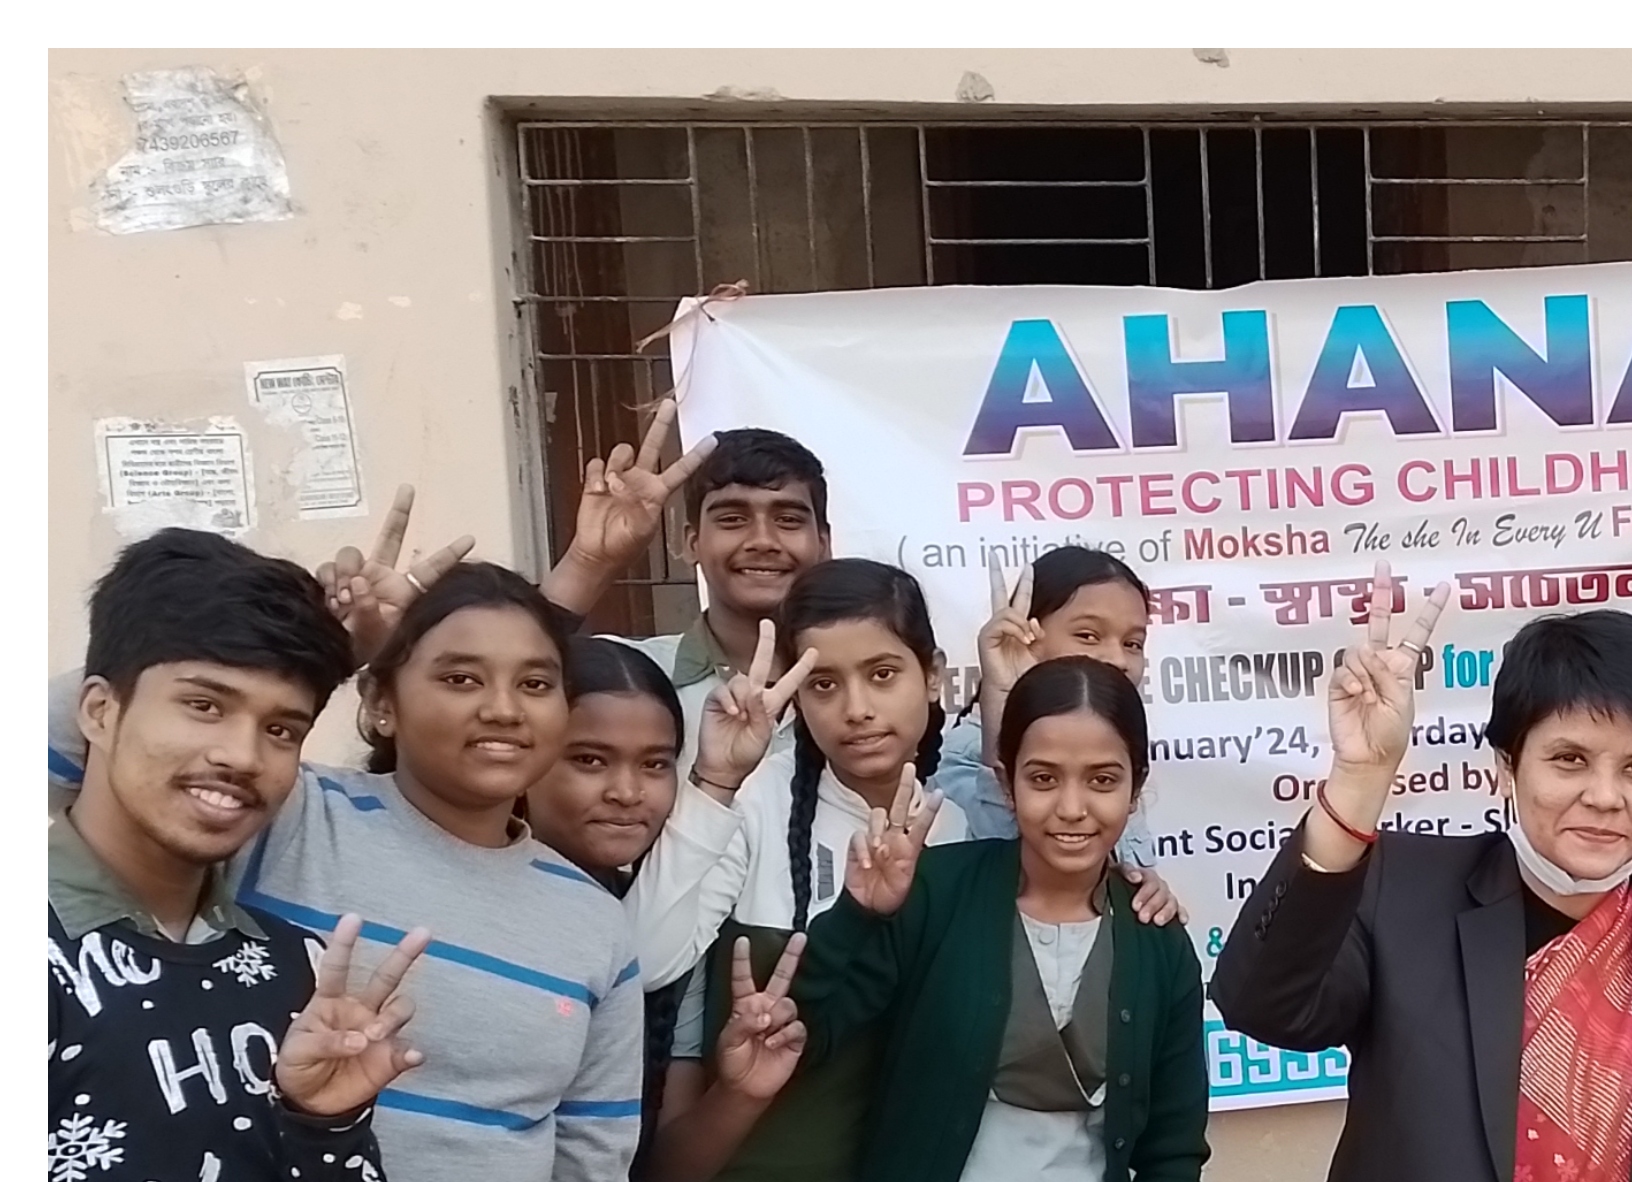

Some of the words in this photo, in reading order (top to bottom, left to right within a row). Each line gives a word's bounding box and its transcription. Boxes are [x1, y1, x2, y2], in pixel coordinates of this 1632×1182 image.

[137, 130, 239, 152] 7439206567
[957, 462, 1375, 523] PROTECTING
[922, 540, 967, 568] an
[1138, 527, 1172, 563] of
[1184, 521, 1330, 561] Moksha
[1343, 522, 1391, 553] The
[1401, 519, 1441, 549] she
[1449, 521, 1481, 546] In
[1492, 514, 1567, 548] Every
[1160, 650, 1324, 705] CHECKUP
[1443, 643, 1494, 689] for
[1150, 725, 1320, 764] nuary’24,
[1412, 716, 1489, 760] rday
[1462, 761, 1499, 796] by
[1206, 820, 1296, 853] Socia
